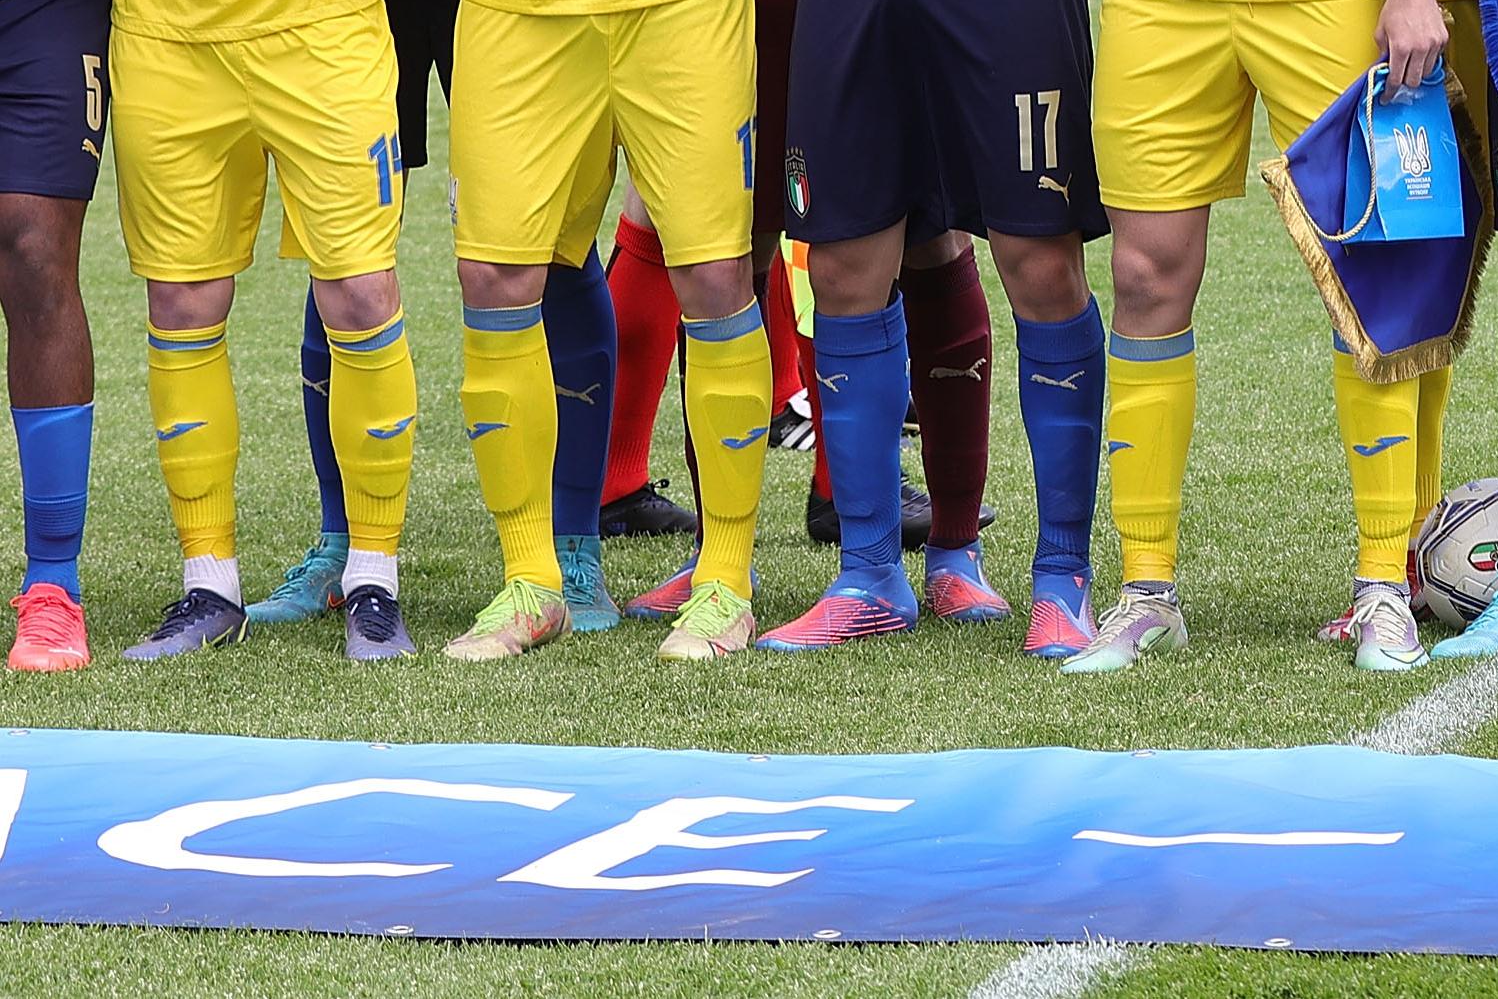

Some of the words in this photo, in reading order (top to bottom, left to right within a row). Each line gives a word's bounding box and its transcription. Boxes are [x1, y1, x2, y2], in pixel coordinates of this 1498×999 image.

[82, 54, 102, 132] 5
[1015, 89, 1061, 171] 17
[0, 768, 915, 891] CE
